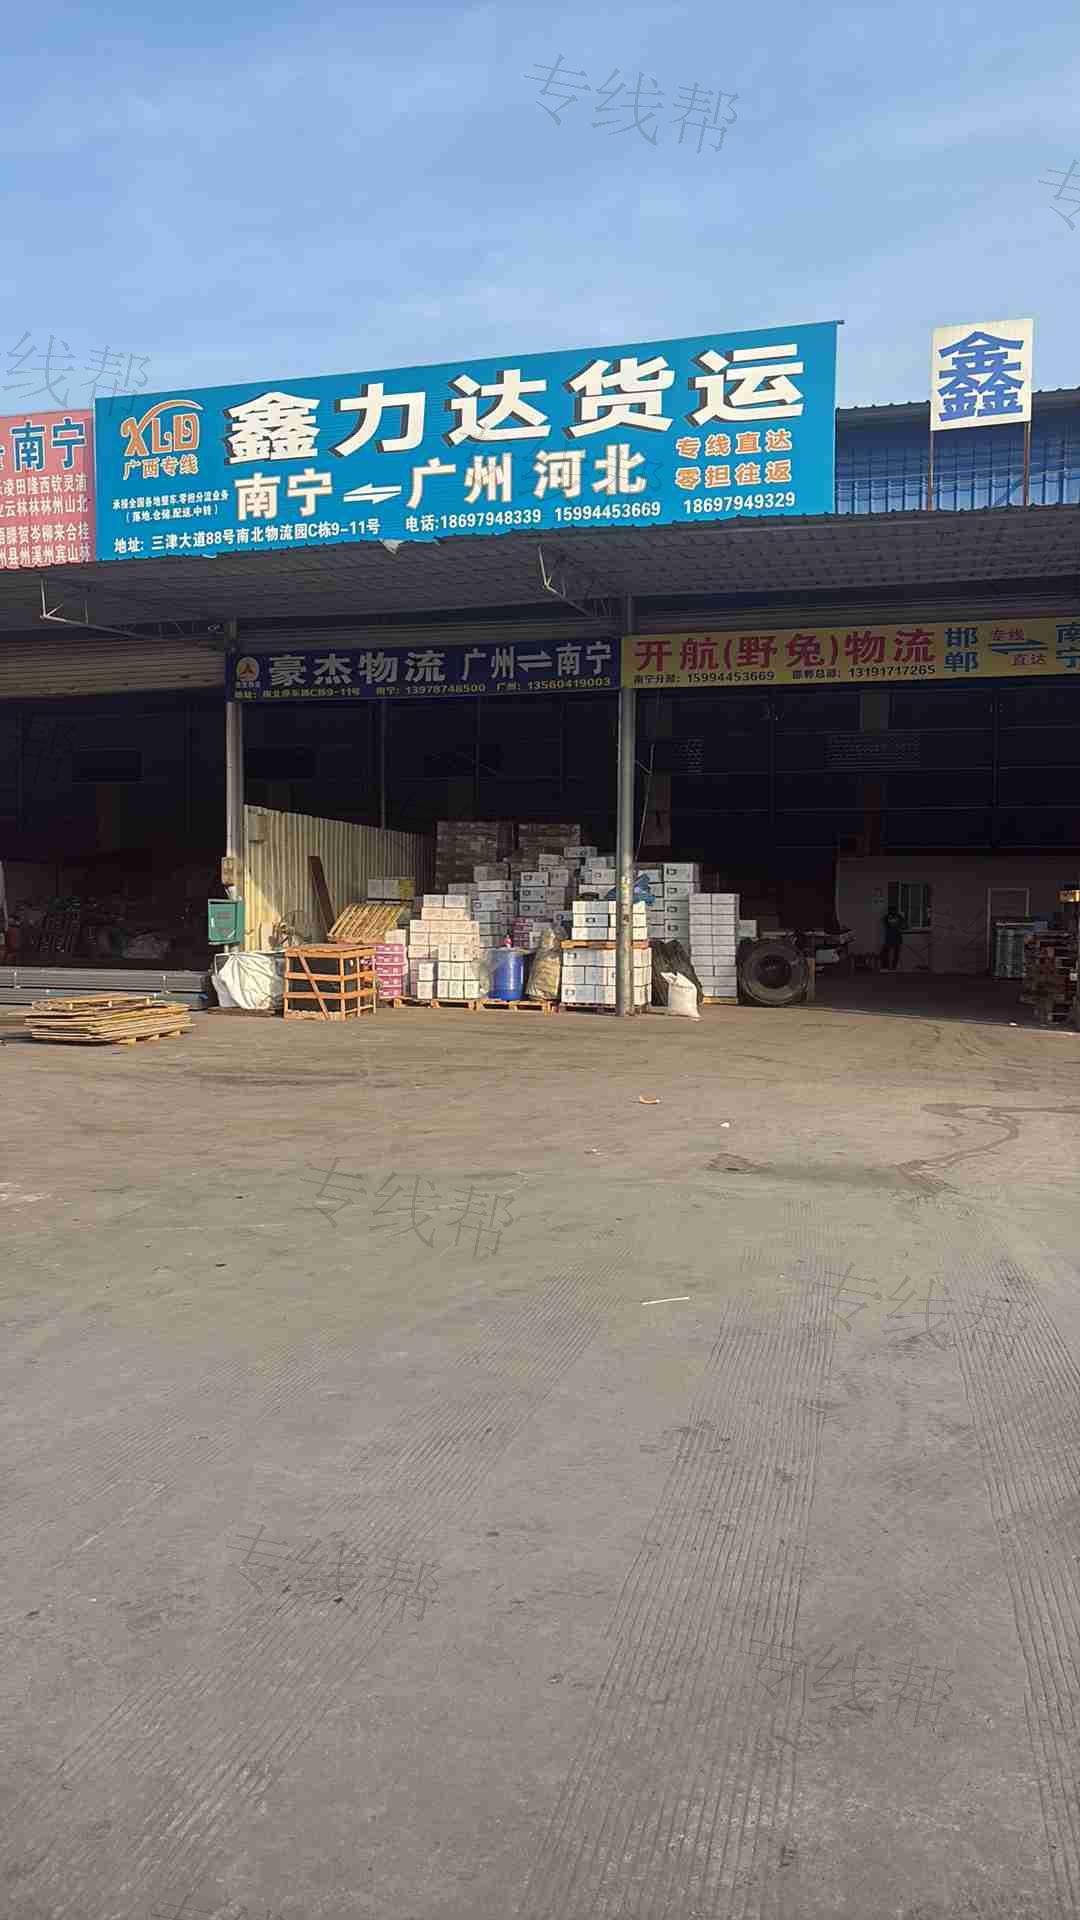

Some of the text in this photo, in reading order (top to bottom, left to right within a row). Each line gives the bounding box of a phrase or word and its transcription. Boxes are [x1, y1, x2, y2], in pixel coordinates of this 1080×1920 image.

[937, 331, 1024, 422] 鑫
[226, 343, 804, 464] 鑫力达货运
[10, 416, 88, 471] 南宁
[676, 428, 792, 459] 专线直达
[123, 453, 199, 481] 广西专线
[234, 468, 333, 521] 南宁
[406, 452, 513, 509] 广州
[532, 443, 648, 499] 河北
[675, 460, 792, 491] 零担往返
[554, 502, 661, 521] 15994453669
[683, 492, 795, 514] 18697949329
[269, 641, 611, 686] 豪杰物流 广州 南宁
[687, 671, 775, 683] 15994453669
